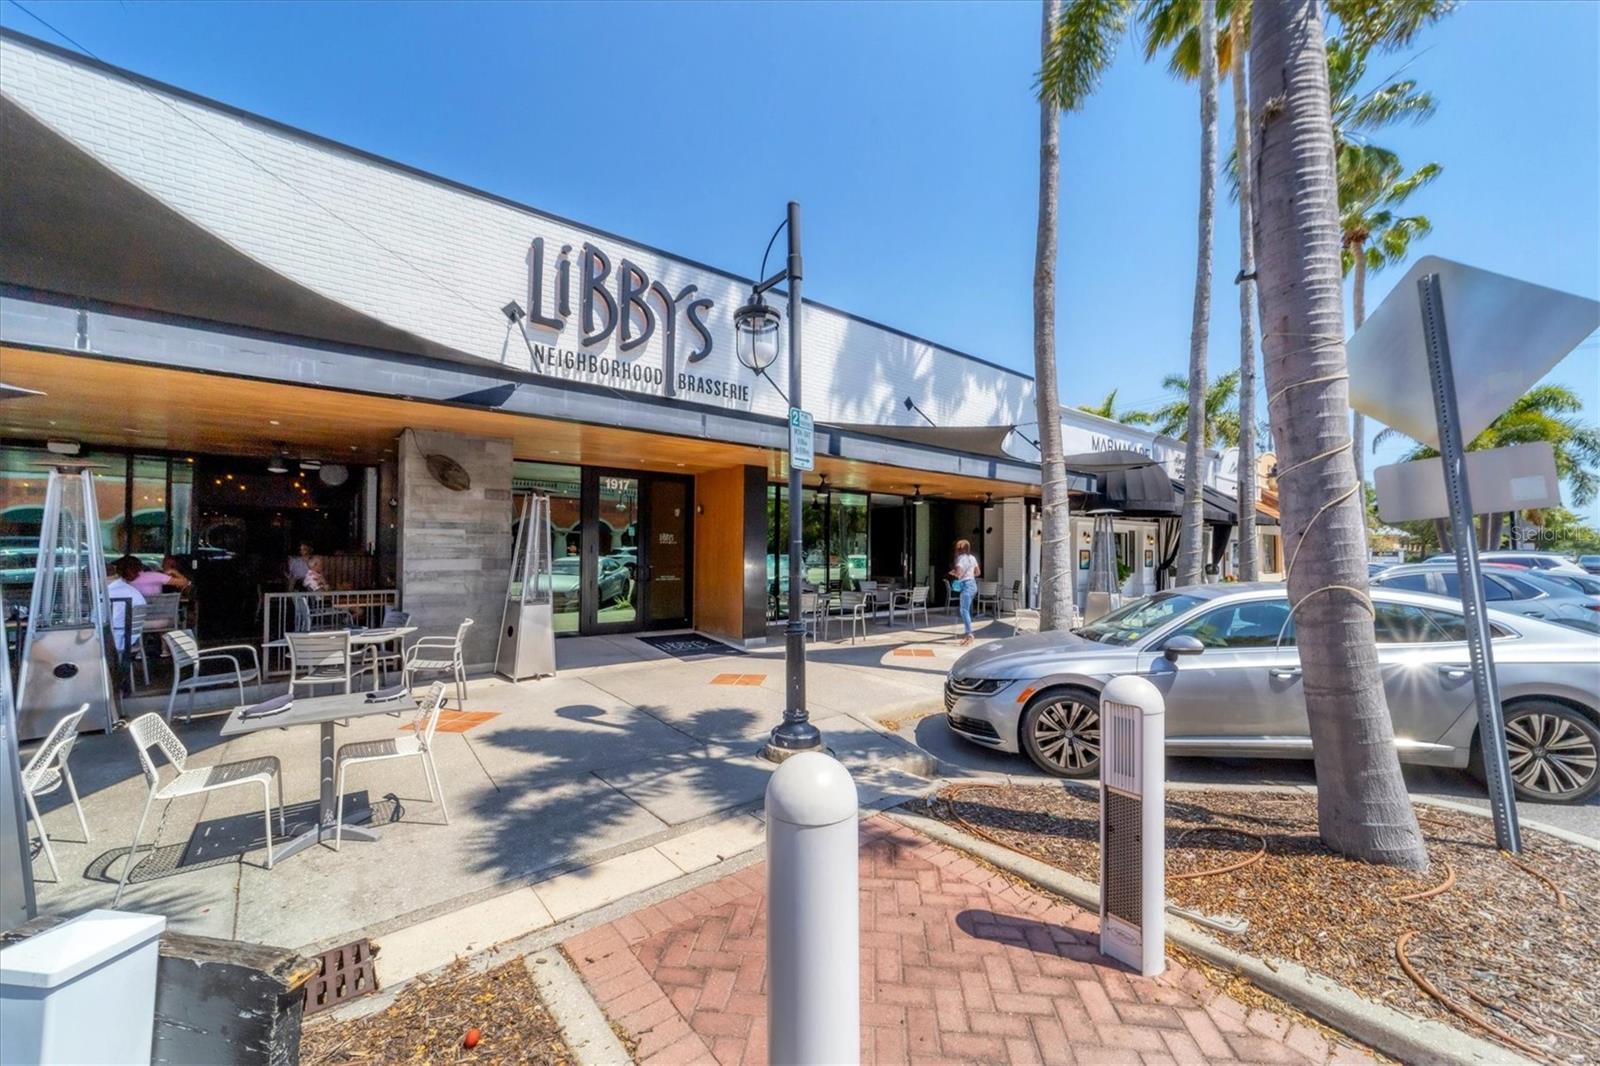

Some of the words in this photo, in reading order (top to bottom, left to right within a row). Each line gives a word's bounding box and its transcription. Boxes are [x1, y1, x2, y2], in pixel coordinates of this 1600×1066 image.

[534, 344, 663, 385] NEIGHBORHOOD
[678, 373, 749, 401] BRASSERIE
[792, 410, 799, 425] 2
[605, 478, 630, 490] 1917
